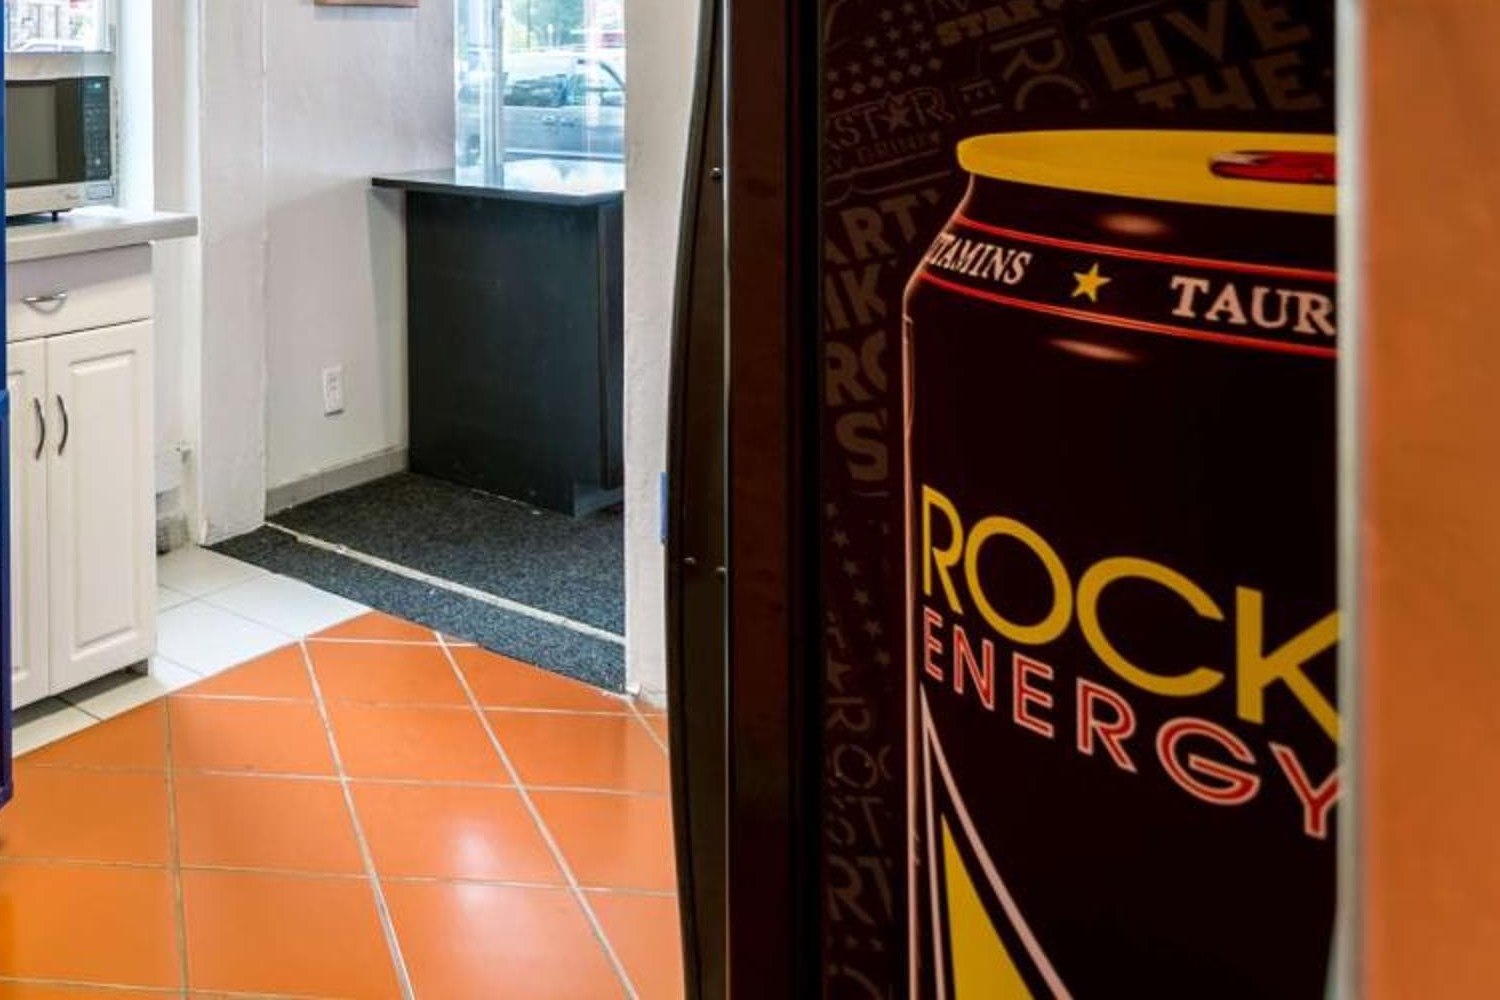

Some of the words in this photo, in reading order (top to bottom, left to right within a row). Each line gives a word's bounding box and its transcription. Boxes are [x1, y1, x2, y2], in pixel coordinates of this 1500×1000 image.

[1169, 274, 1337, 337] TAUR
[921, 482, 1342, 744] ROCK
[922, 604, 1341, 840] ENERGY
